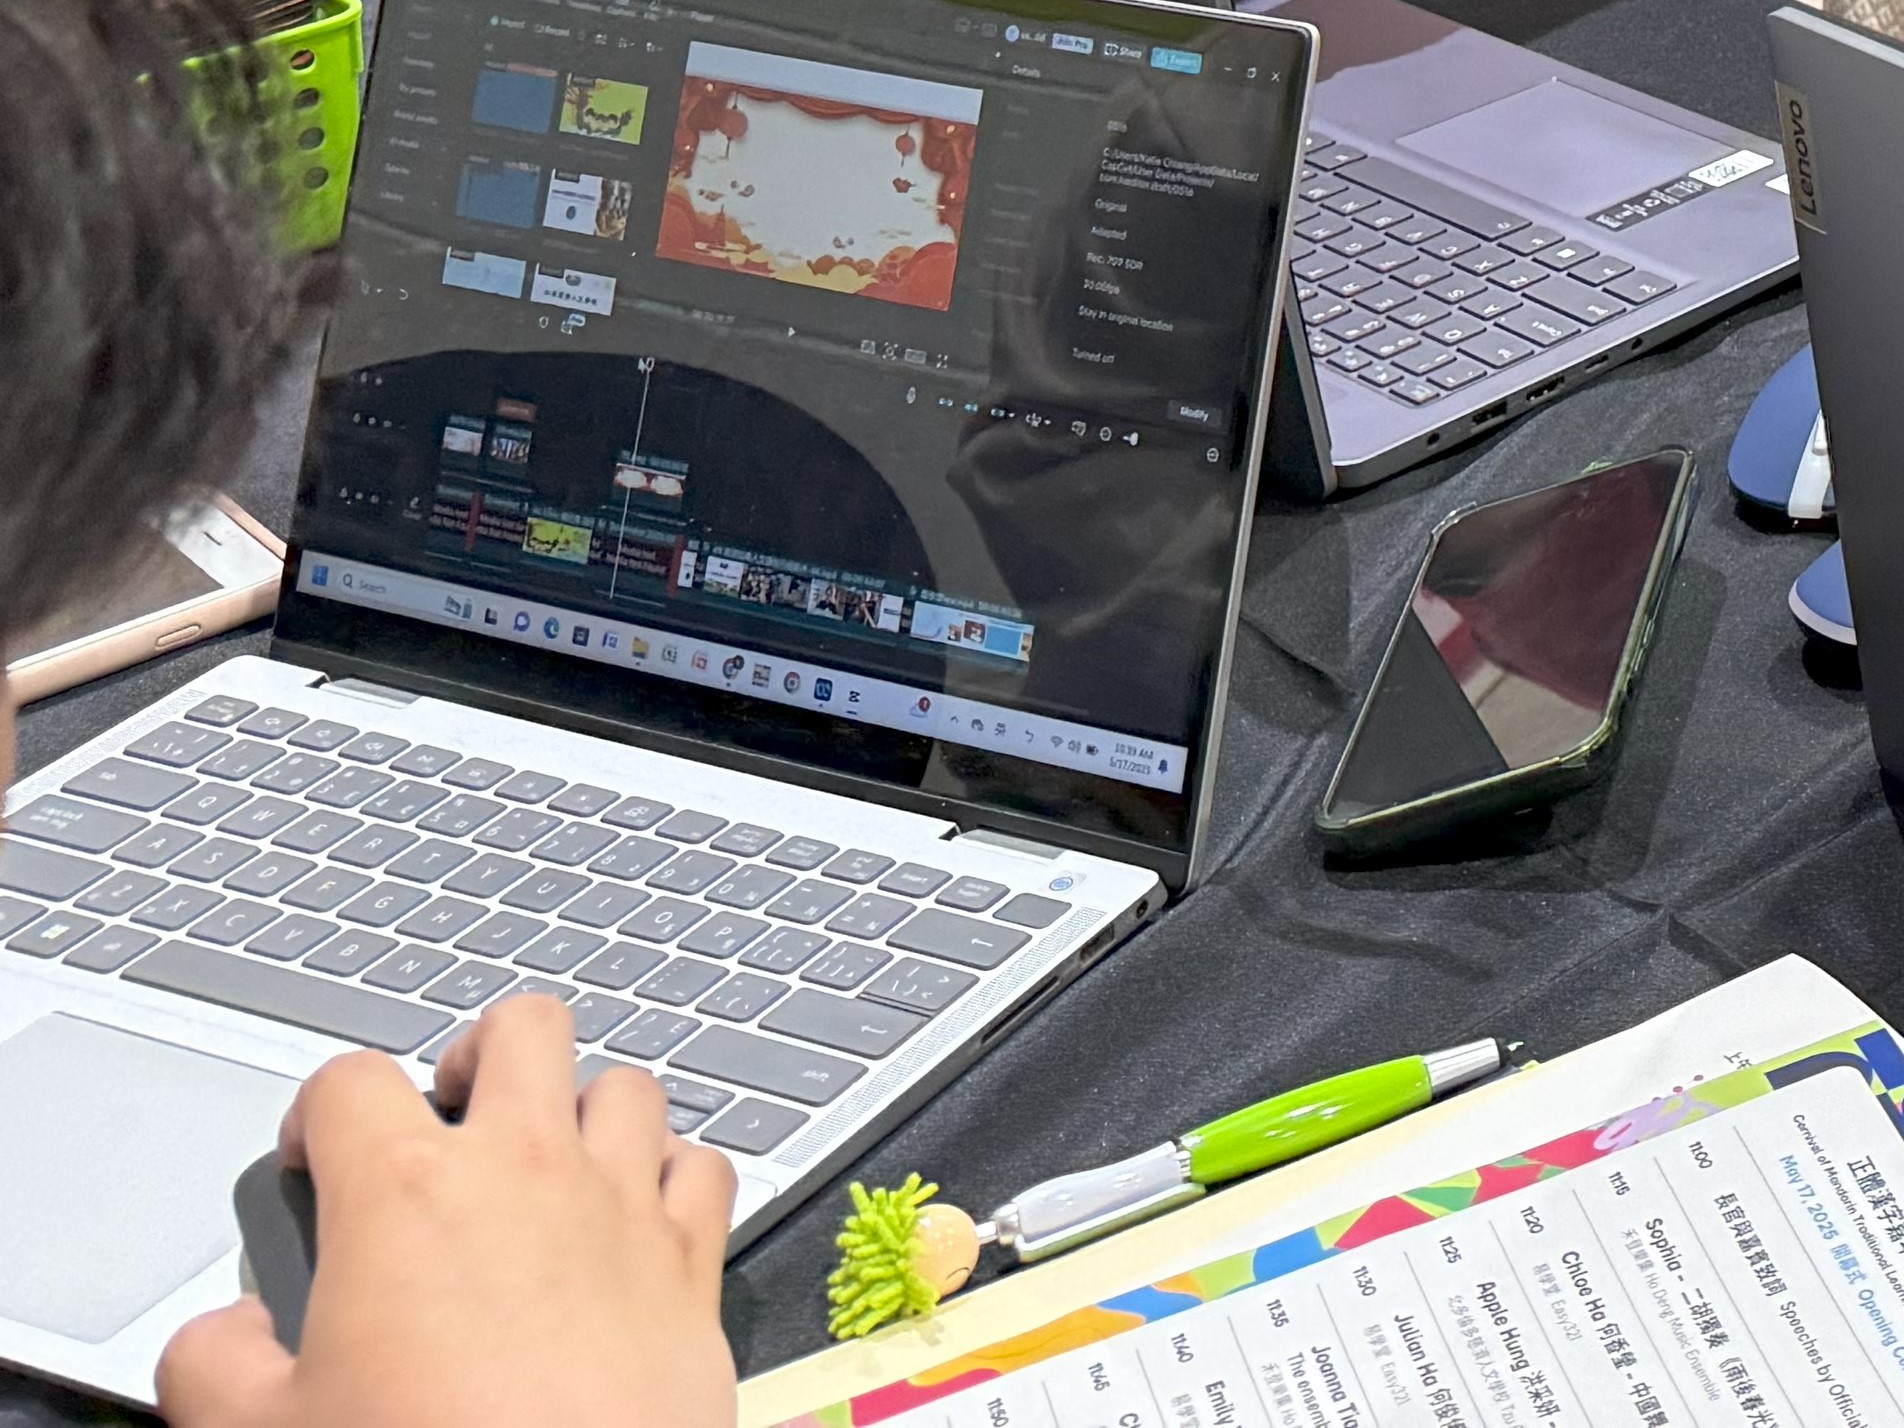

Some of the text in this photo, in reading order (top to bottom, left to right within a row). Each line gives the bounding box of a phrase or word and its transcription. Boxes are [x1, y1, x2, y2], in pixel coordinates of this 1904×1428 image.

[1789, 99, 1817, 216] Lenovo
[358, 579, 387, 595] Search
[1688, 1140, 1713, 1170] 11:00
[1792, 1114, 1825, 1156] Carnival
[1817, 1154, 1829, 1166] of
[1822, 1165, 1859, 1219] Mandarin
[1520, 1205, 1544, 1235] 11:20
[1439, 1235, 1463, 1265] 11:25
[1778, 1154, 1803, 1185] May
[1797, 1182, 1813, 1207] 17,
[1807, 1204, 1840, 1241] 2025
[1829, 1236, 1868, 1285] 開幕式
[1856, 1288, 1900, 1349] Opening
[1851, 1215, 1893, 1272] Traditional
[1353, 1264, 1377, 1296] 11:30
[1561, 1249, 1593, 1297] Chloe
[1585, 1296, 1606, 1323] Ha
[1645, 1217, 1683, 1273] Sophia
[1681, 1287, 1730, 1350] 二胡獨奏
[1714, 1192, 1788, 1297] 長官與嘉賓致詞
[1779, 1299, 1823, 1366] Speeches
[1816, 1363, 1832, 1385] by
[1266, 1298, 1290, 1328] 11:35
[1476, 1280, 1509, 1327] Apple
[1499, 1326, 1531, 1373] Hung
[1551, 1298, 1584, 1343] Easy321
[1171, 1332, 1195, 1364] 11:40
[1394, 1313, 1426, 1364] Julian
[1416, 1361, 1438, 1388] Ha
[1644, 1272, 1660, 1290] Ho
[1652, 1288, 1676, 1321] Deng
[1668, 1317, 1690, 1350] Music
[1684, 1347, 1721, 1402] Ensemble
[1088, 1361, 1112, 1393] 11:45
[1286, 1351, 1306, 1380] The
[1311, 1345, 1347, 1404] Joanna
[1380, 1361, 1412, 1408] Easy321
[987, 1396, 1010, 1428] 11:50
[1205, 1379, 1235, 1428] Emily
